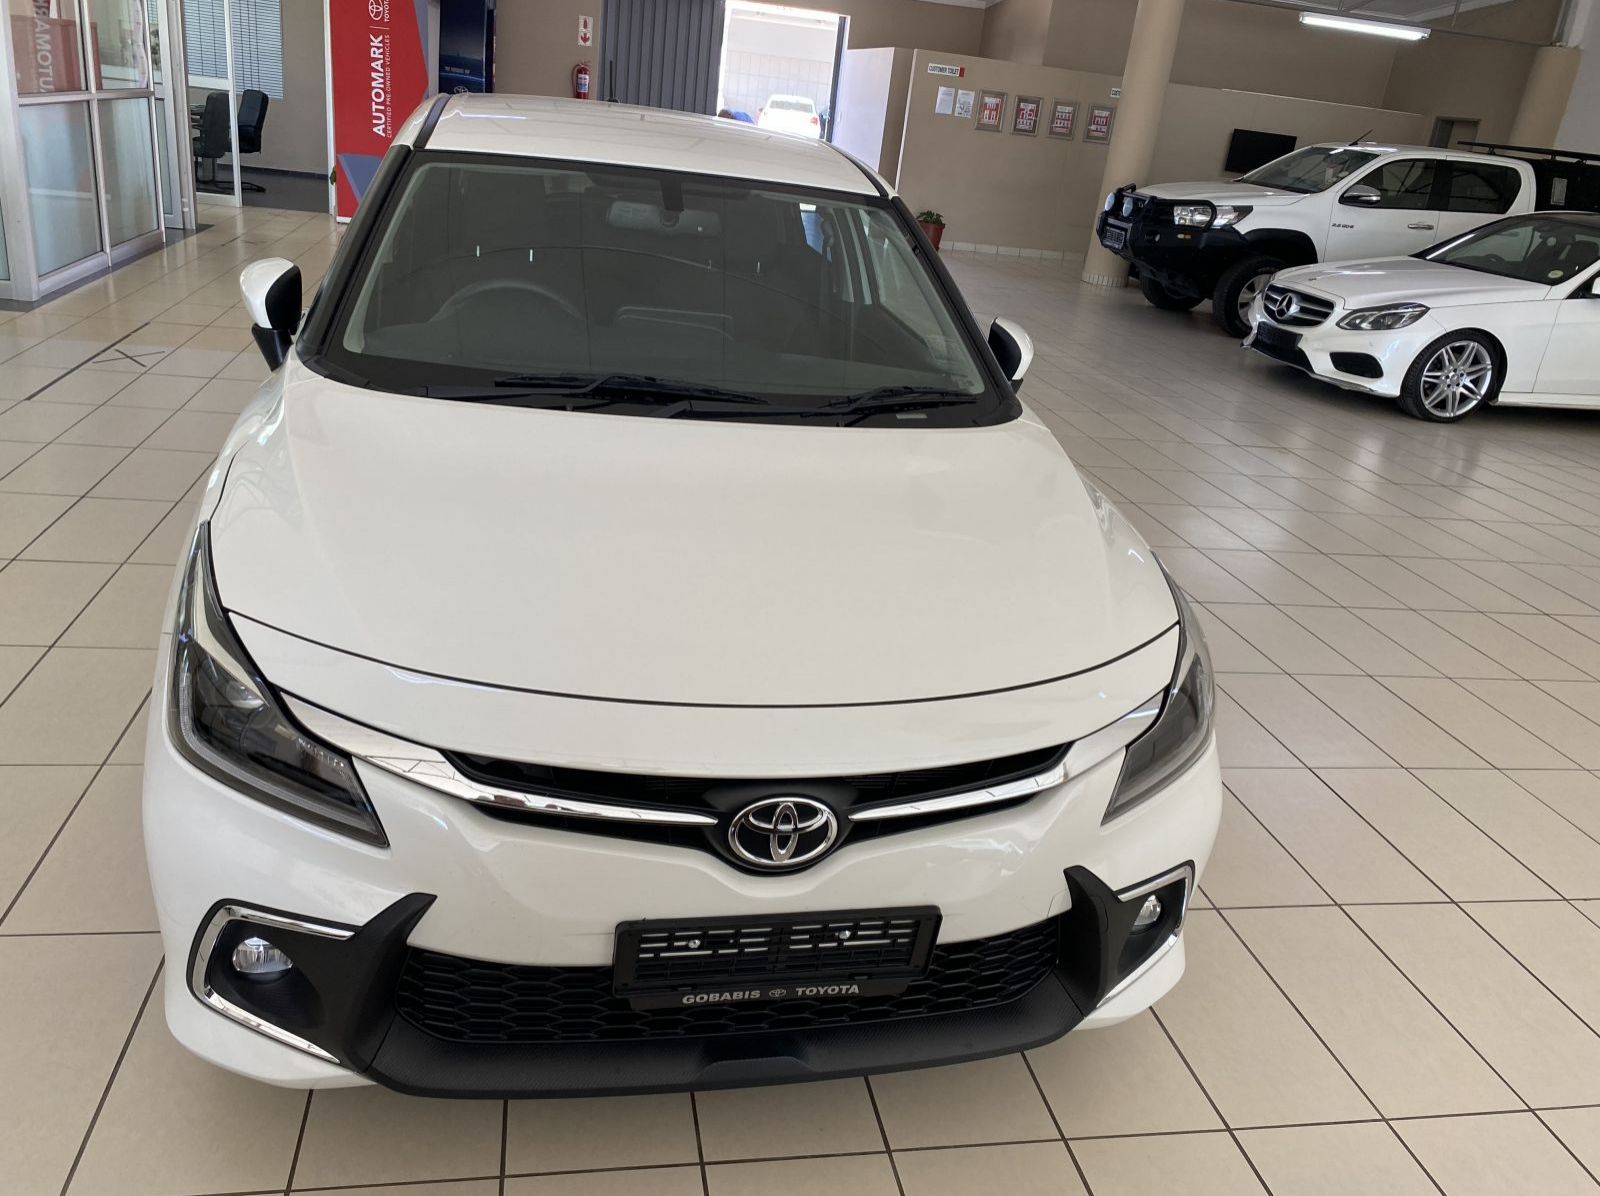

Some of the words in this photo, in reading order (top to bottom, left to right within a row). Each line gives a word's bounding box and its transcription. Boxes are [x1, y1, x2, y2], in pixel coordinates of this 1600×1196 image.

[928, 64, 948, 74] CUSTOMER
[948, 67, 960, 76] TOILET
[370, 33, 385, 137] AUTOMARK
[682, 990, 761, 1005] GOBABIS
[796, 985, 860, 996] TOYOTA
